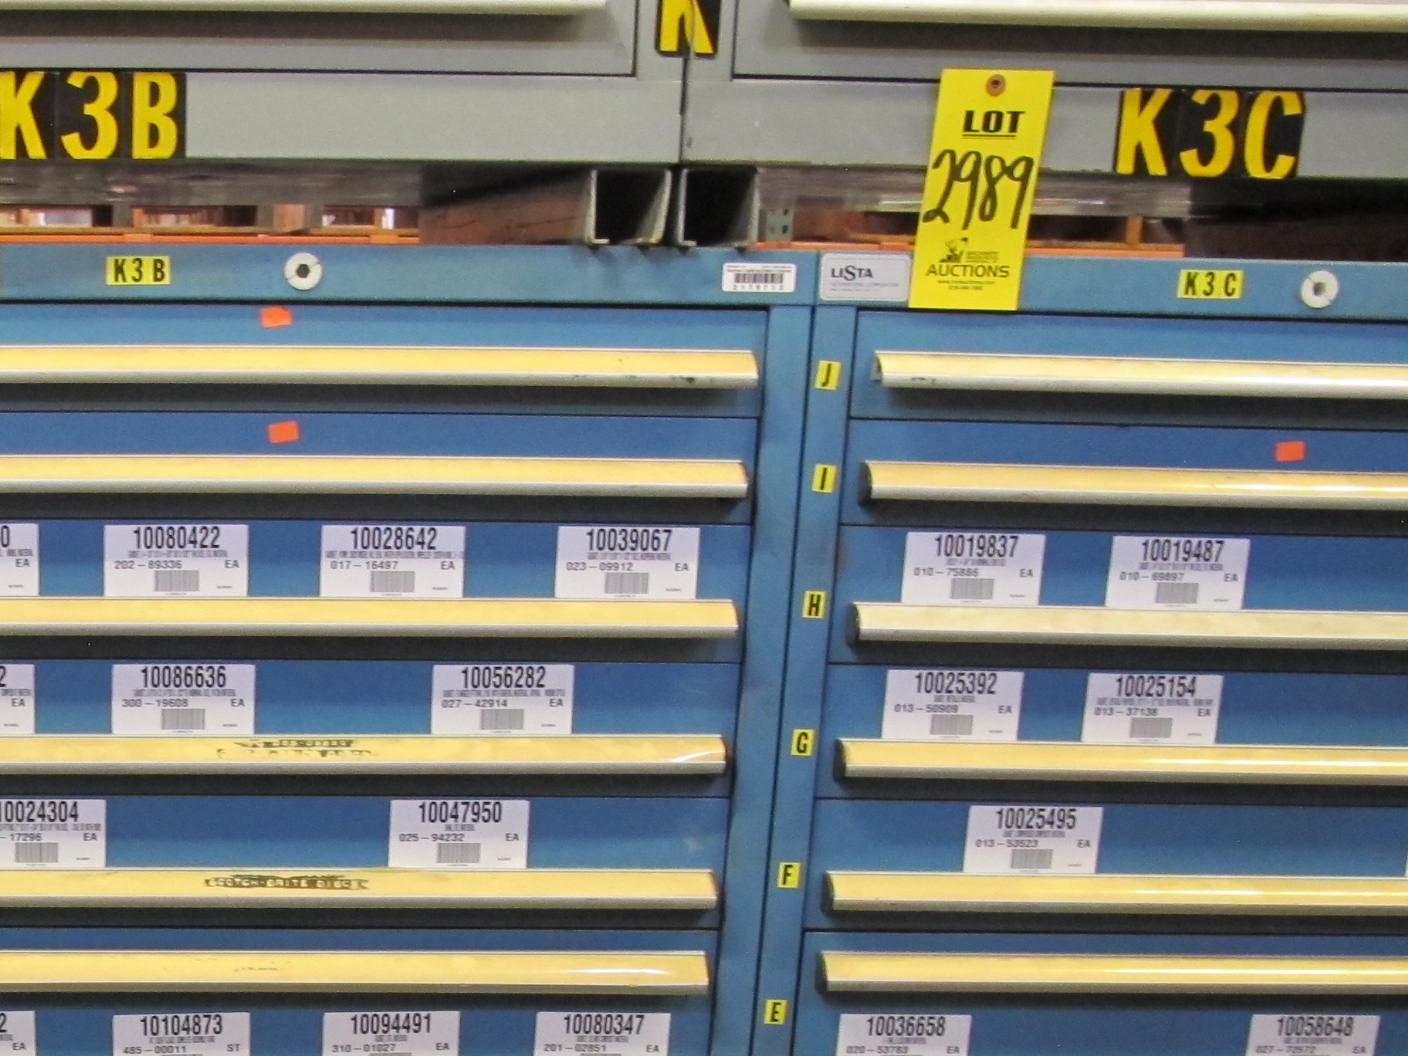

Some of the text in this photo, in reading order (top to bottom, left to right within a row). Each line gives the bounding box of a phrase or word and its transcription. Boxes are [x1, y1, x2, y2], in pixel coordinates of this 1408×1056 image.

[962, 110, 1026, 134] LOT
[923, 149, 1034, 230] 2989
[831, 265, 873, 281] LISTA
[925, 264, 1010, 278] AUCTIONS
[822, 364, 832, 386] J
[133, 527, 220, 548] 10080422
[350, 528, 437, 550] 10028642
[586, 530, 673, 551] 10039067
[935, 535, 1018, 558] 10019837
[1142, 540, 1224, 562] 10019487
[16, 559, 30, 567] EA
[441, 561, 455, 570] EA
[1020, 569, 1033, 577] EA
[808, 595, 819, 616] H
[141, 667, 226, 688] 10086636
[461, 667, 545, 688] 10056282
[915, 673, 997, 695] 10025392
[1116, 676, 1196, 698] 10025154
[11, 699, 25, 707] EA
[549, 699, 563, 707] EA
[998, 706, 1012, 714] EA
[796, 732, 808, 753] G
[418, 802, 501, 822] 10047950
[996, 808, 1076, 829] 10025495
[1077, 840, 1090, 848] EA
[782, 865, 793, 885] F
[772, 1002, 781, 1022] E
[140, 1016, 223, 1036] 10104873
[351, 1014, 431, 1034] 10094491
[564, 1015, 644, 1034] 10080347
[867, 1017, 945, 1036] 10036658
[947, 1046, 960, 1054] EA
